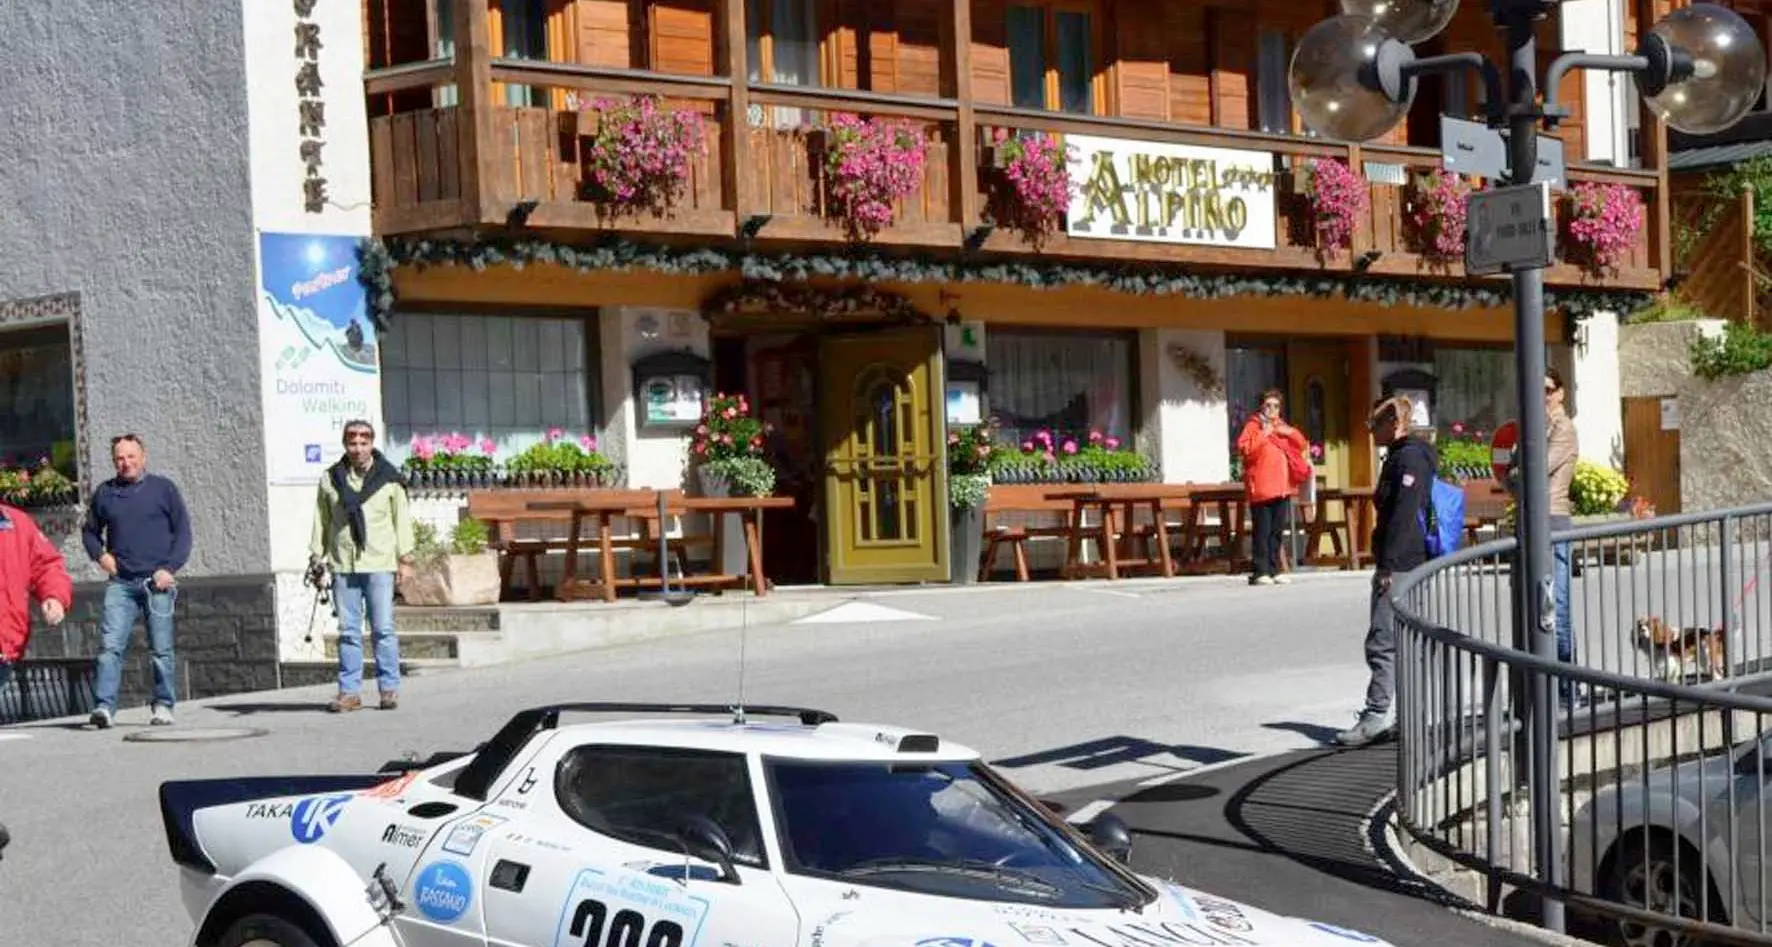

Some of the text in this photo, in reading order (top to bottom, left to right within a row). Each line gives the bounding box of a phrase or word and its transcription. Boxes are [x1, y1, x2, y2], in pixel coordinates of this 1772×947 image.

[1127, 152, 1218, 190] HOTEL
[1078, 151, 1248, 234] ALPINO
[275, 378, 347, 396] Dolomiti
[301, 398, 368, 416] Walking
[245, 803, 293, 819] TAKA
